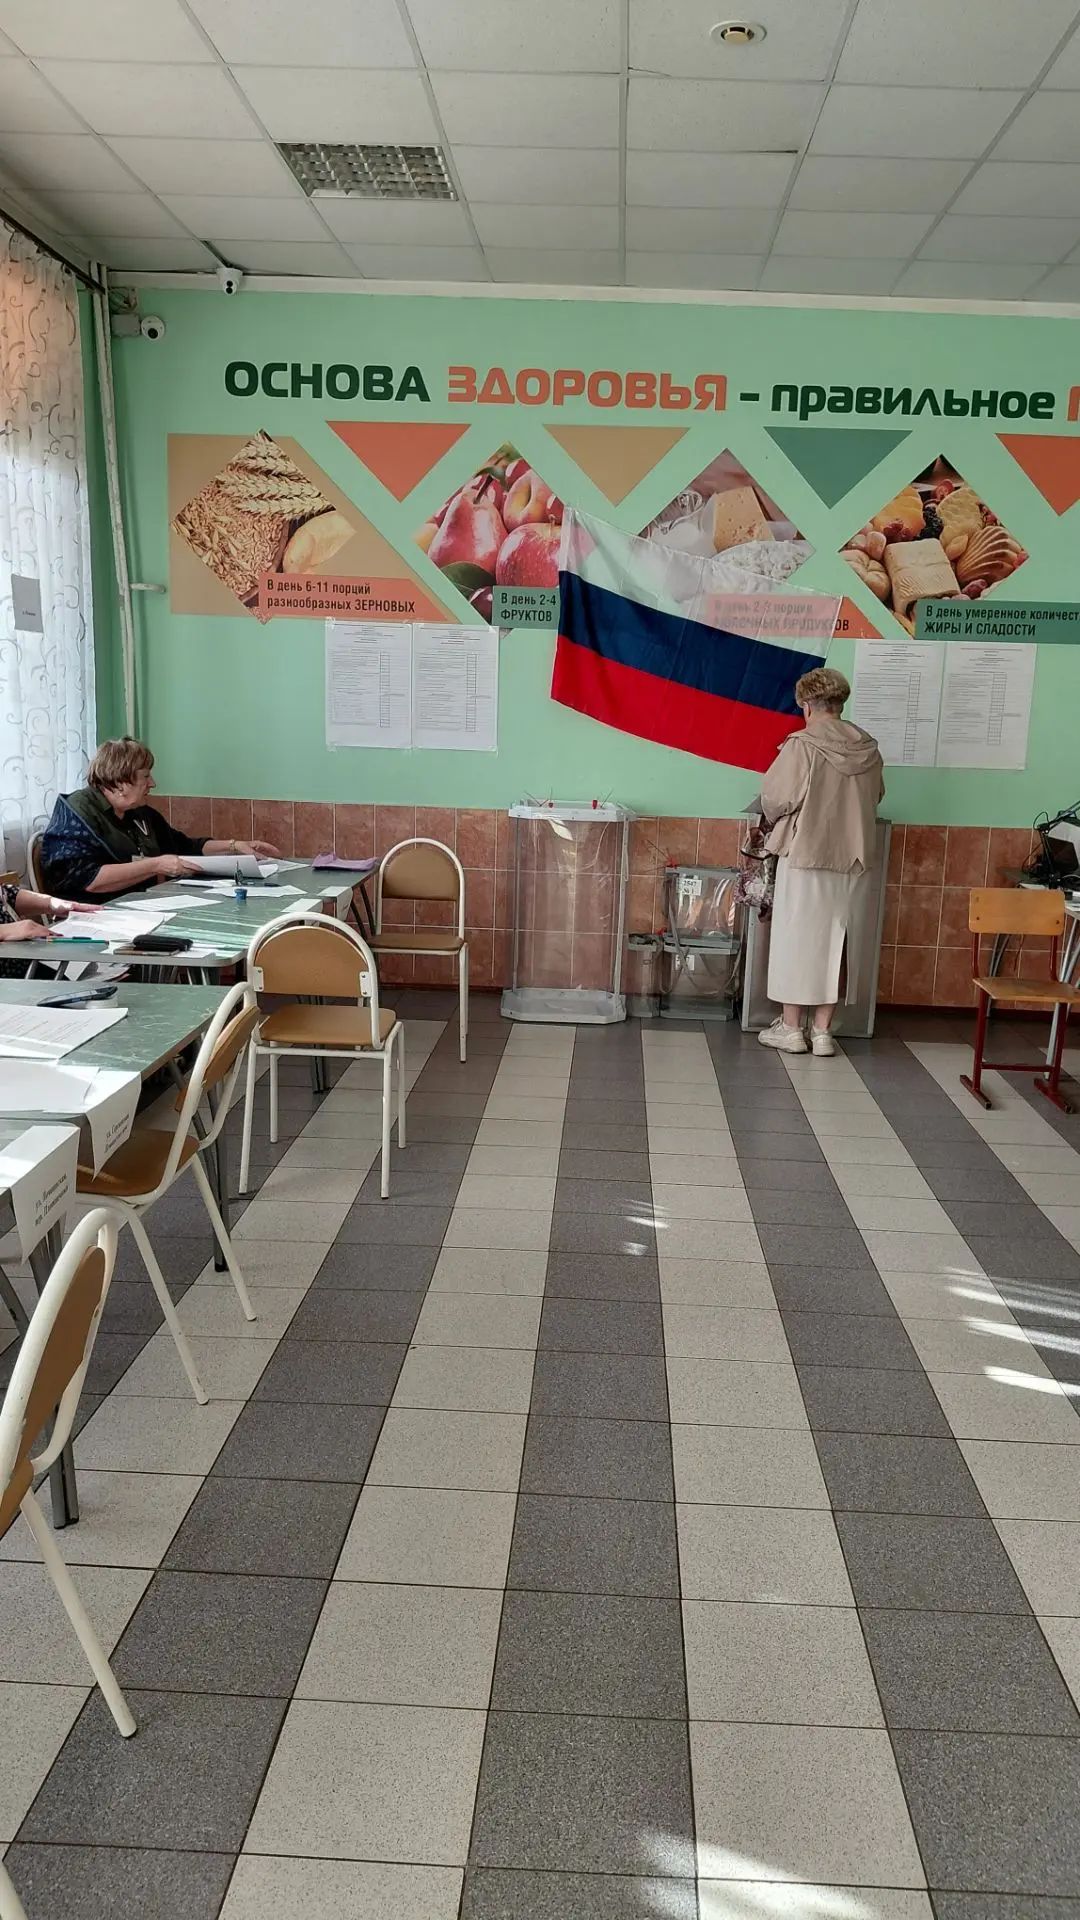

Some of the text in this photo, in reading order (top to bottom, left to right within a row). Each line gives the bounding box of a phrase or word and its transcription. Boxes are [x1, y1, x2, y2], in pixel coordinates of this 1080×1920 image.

[224, 360, 431, 402] ОСНОВА
[447, 366, 728, 411] ЗДОРОВЬЯ
[771, 384, 1055, 421] правильное
[267, 579, 371, 596] В день 6-11 порций
[267, 597, 415, 613] разнообразных ЗЕРНОВЫХ
[501, 592, 557, 606] В день 2-4
[500, 608, 552, 622] ФРУКТОВ
[926, 605, 933, 617] В
[936, 607, 962, 619] день
[965, 608, 1027, 620] умеренное
[924, 622, 1036, 636] ЖИРЫ И СЛАДОСТИ
